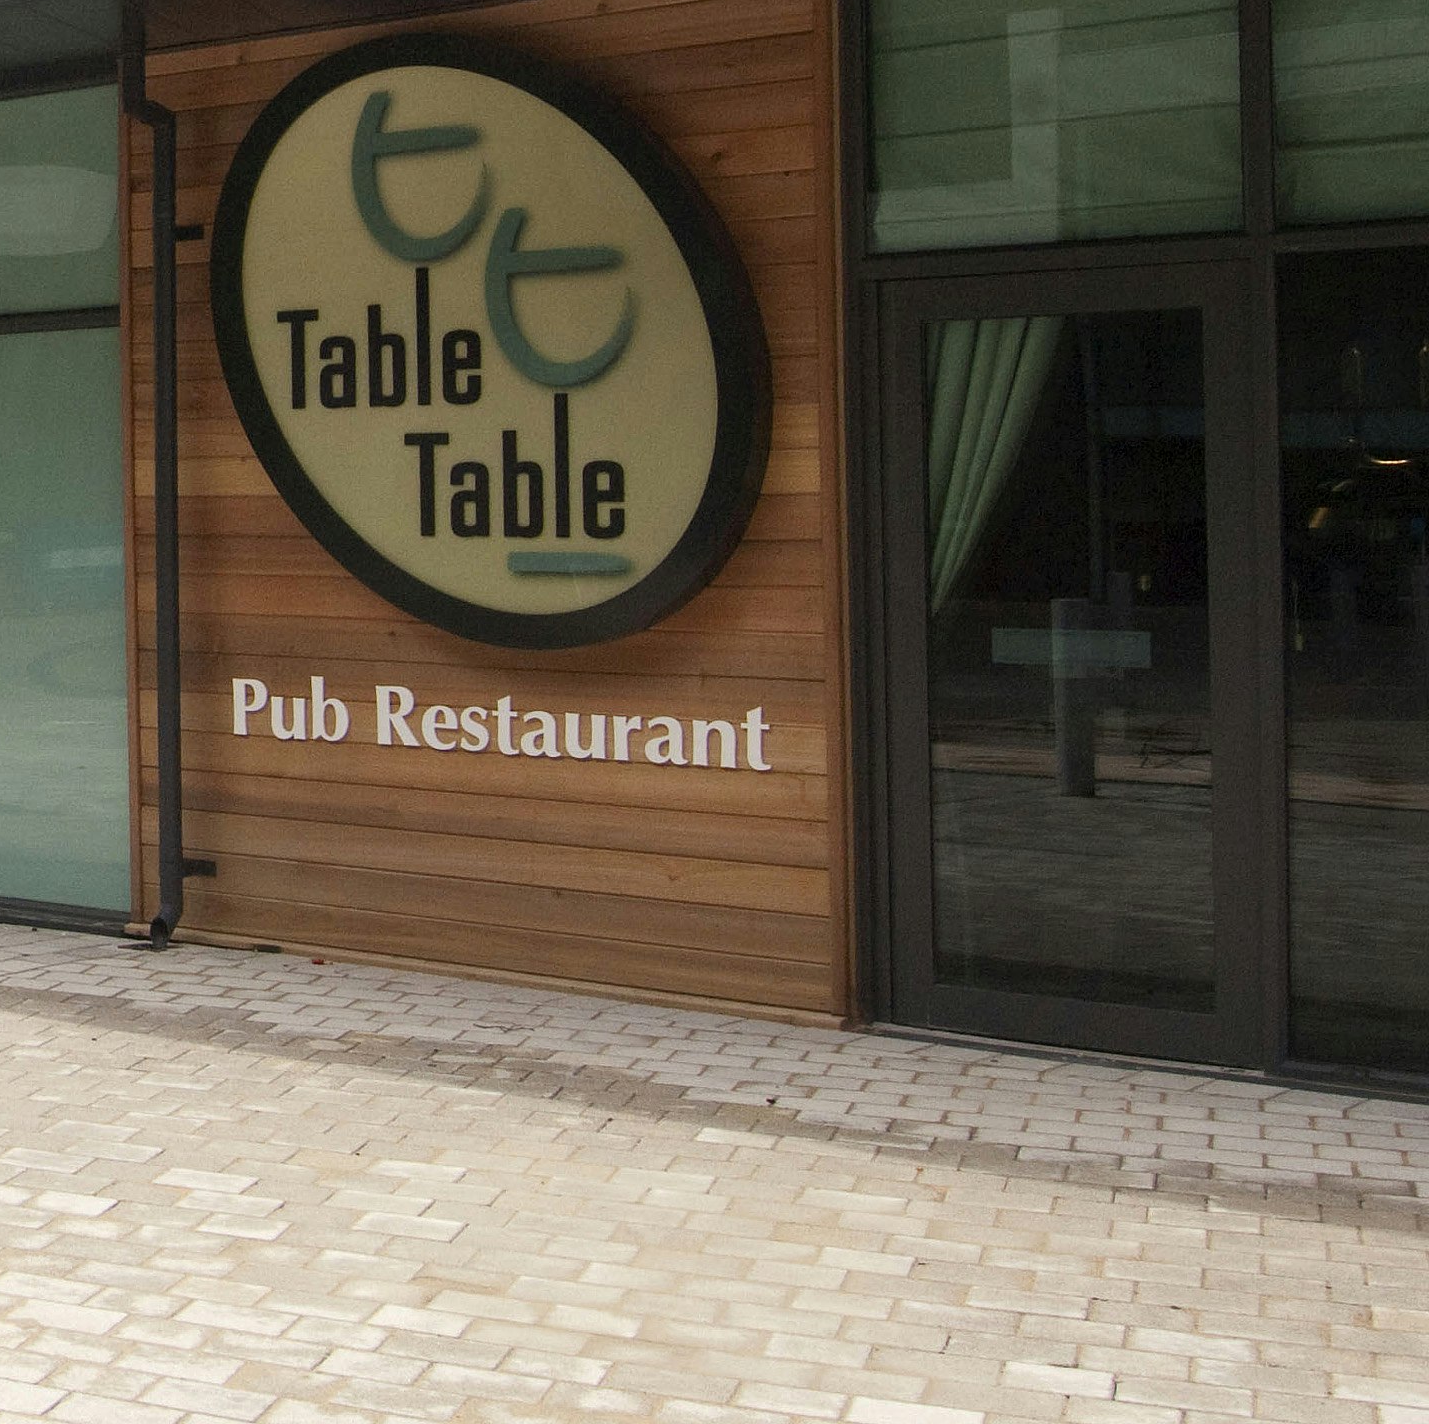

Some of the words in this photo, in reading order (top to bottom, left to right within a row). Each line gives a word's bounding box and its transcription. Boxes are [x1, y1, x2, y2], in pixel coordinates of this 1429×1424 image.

[276, 267, 483, 410] Table
[404, 392, 627, 539] Table
[232, 675, 350, 743] Pub
[375, 684, 773, 772] Restaurant
